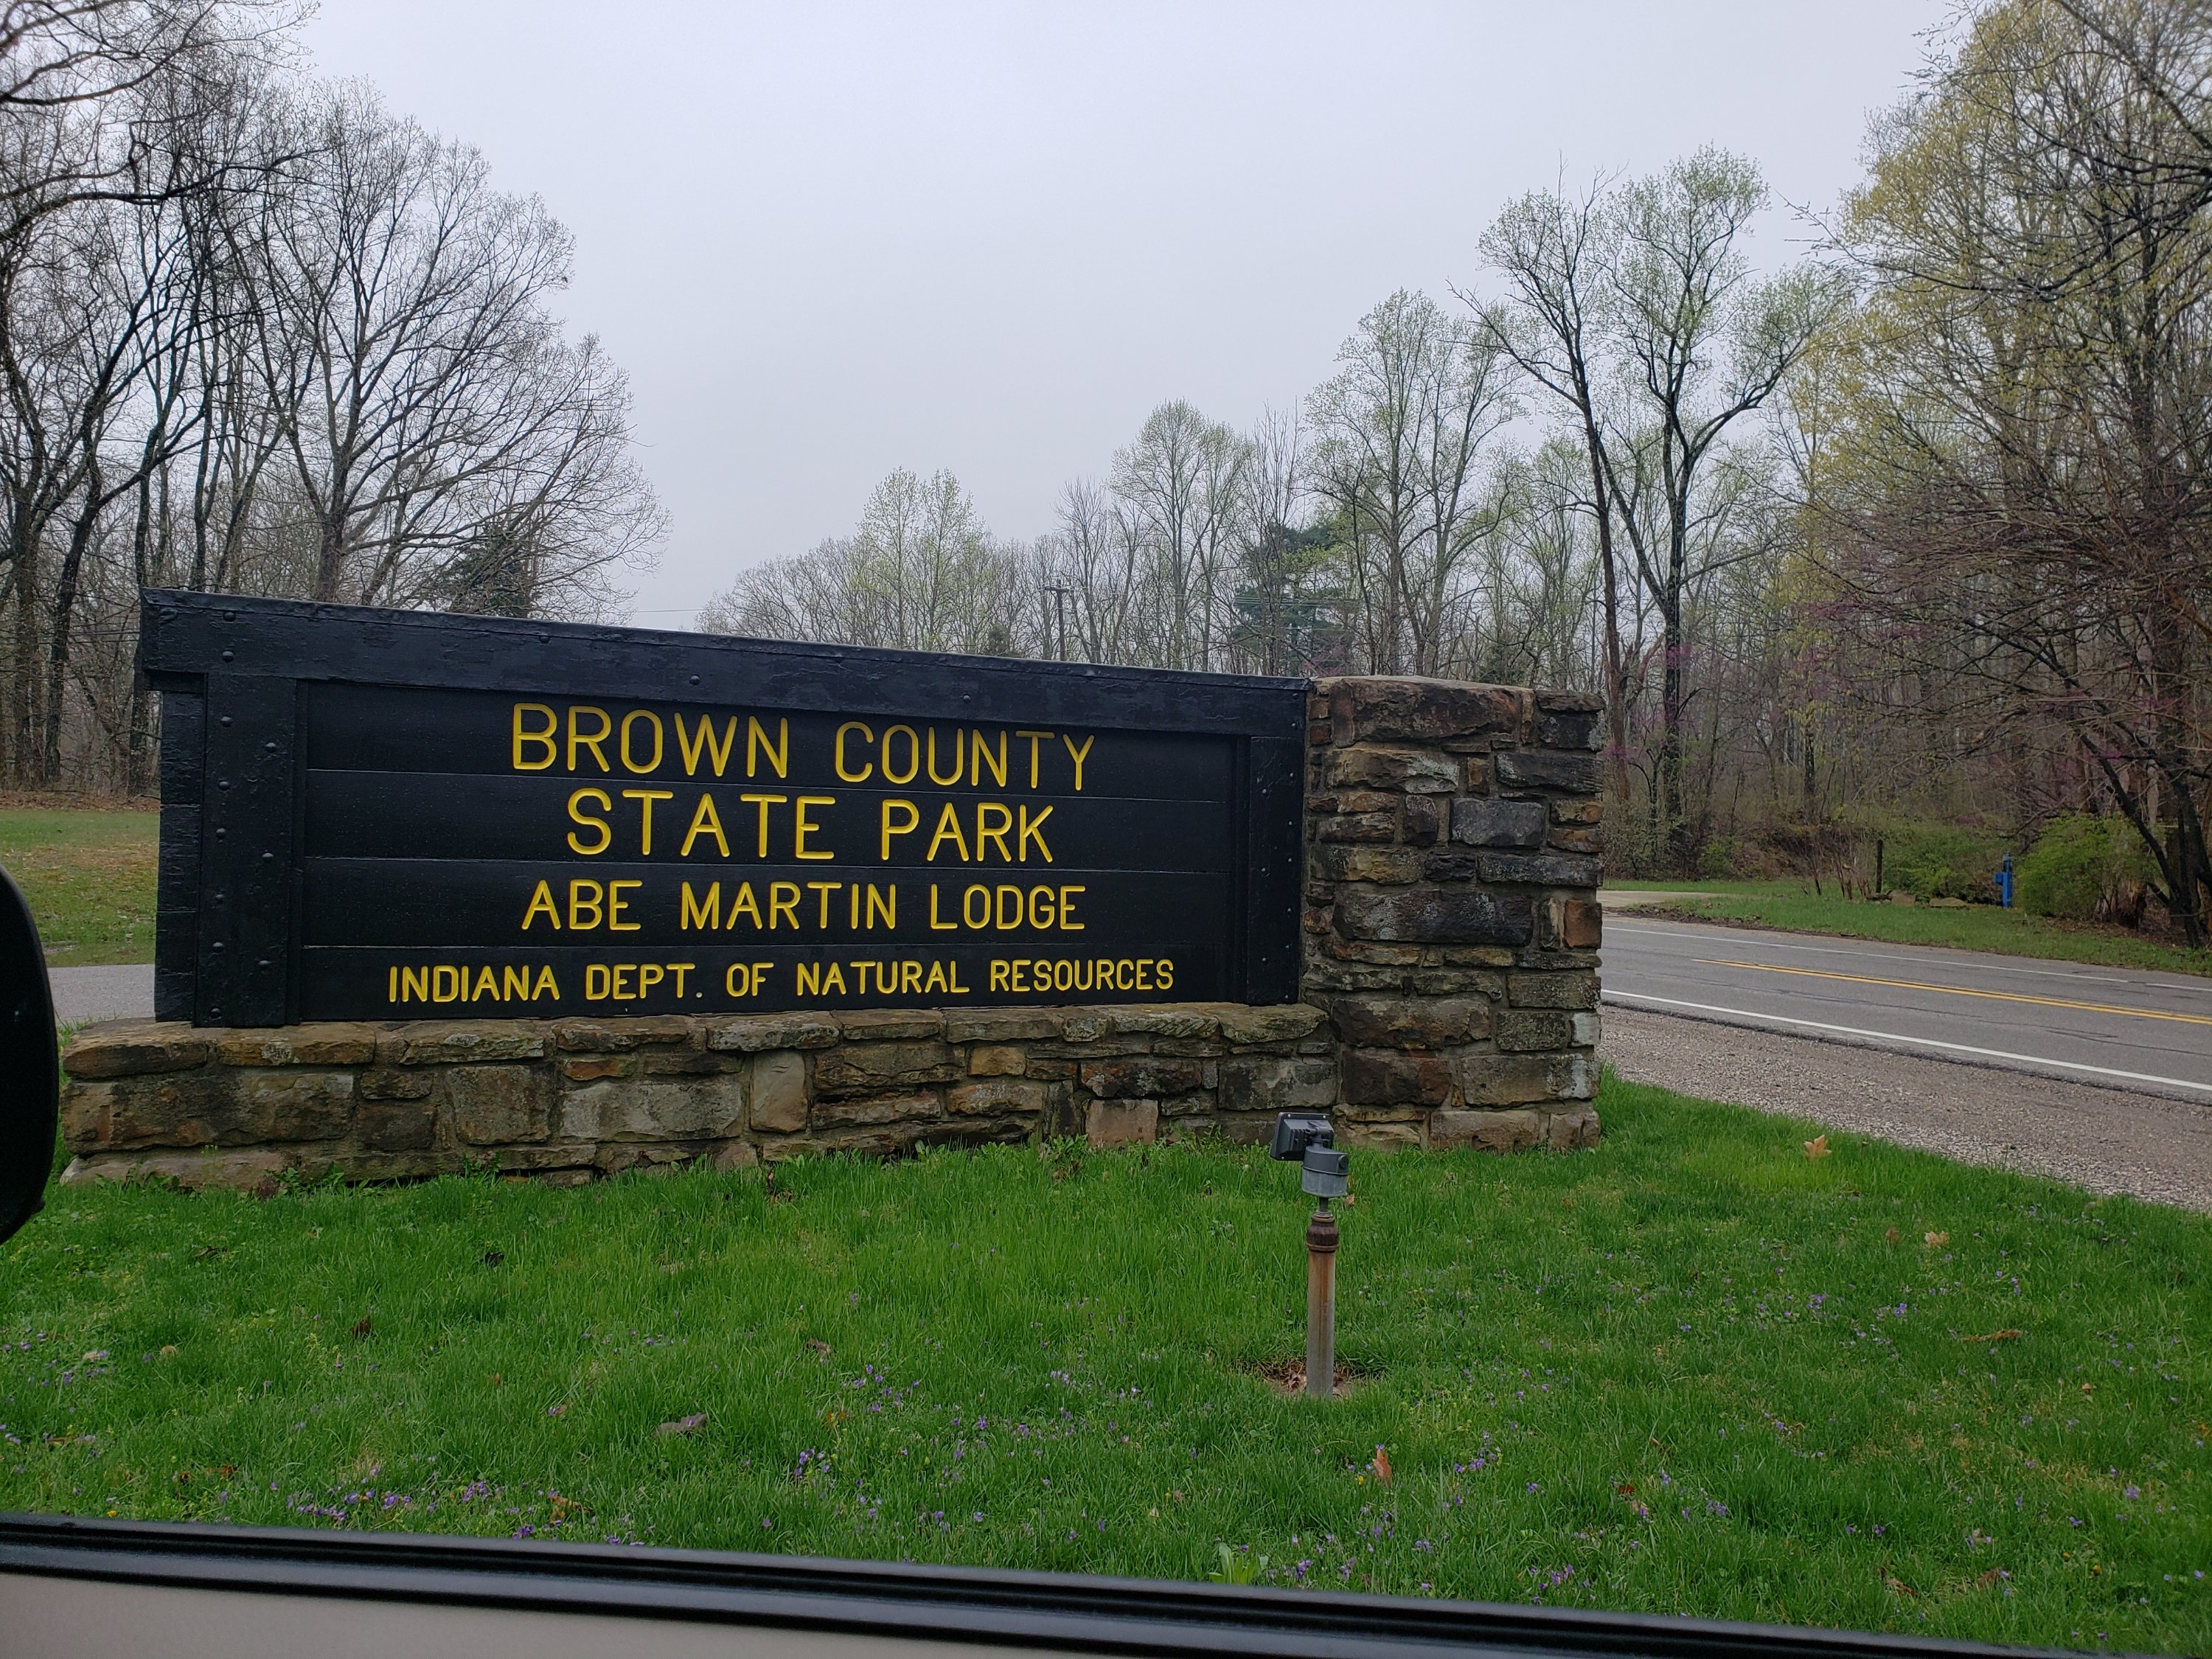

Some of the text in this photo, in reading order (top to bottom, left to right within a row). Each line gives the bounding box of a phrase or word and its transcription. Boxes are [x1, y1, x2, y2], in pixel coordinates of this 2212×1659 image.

[512, 703, 1096, 792] BROWN COUNTY
[566, 787, 1054, 863] STATE PARK
[521, 879, 1087, 931] ABE MARTIN LODGE
[388, 958, 1175, 1004] INDIANA DEPT. OF NATURAL RESOURCES
